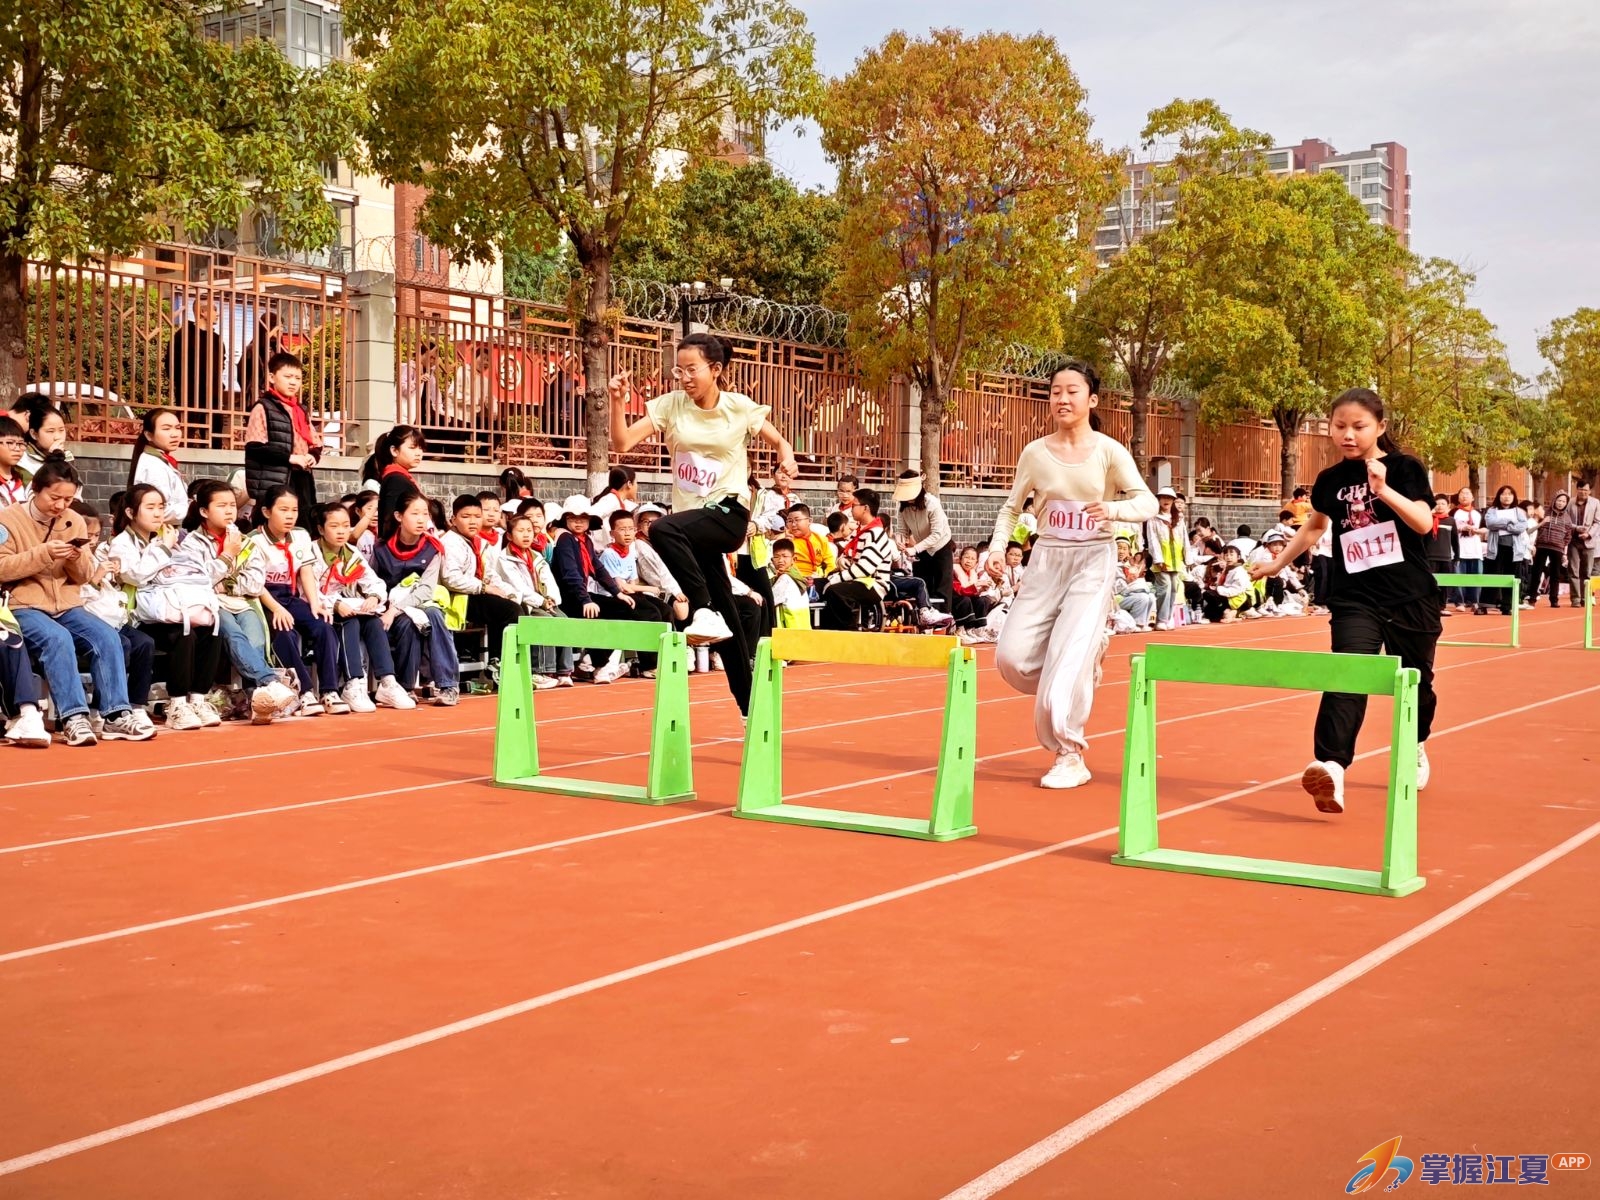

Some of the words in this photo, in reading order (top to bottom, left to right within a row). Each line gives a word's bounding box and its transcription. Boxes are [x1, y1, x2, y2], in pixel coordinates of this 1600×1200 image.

[677, 462, 717, 488] 60220
[1048, 509, 1096, 531] 60116
[1346, 532, 1395, 564] 60117
